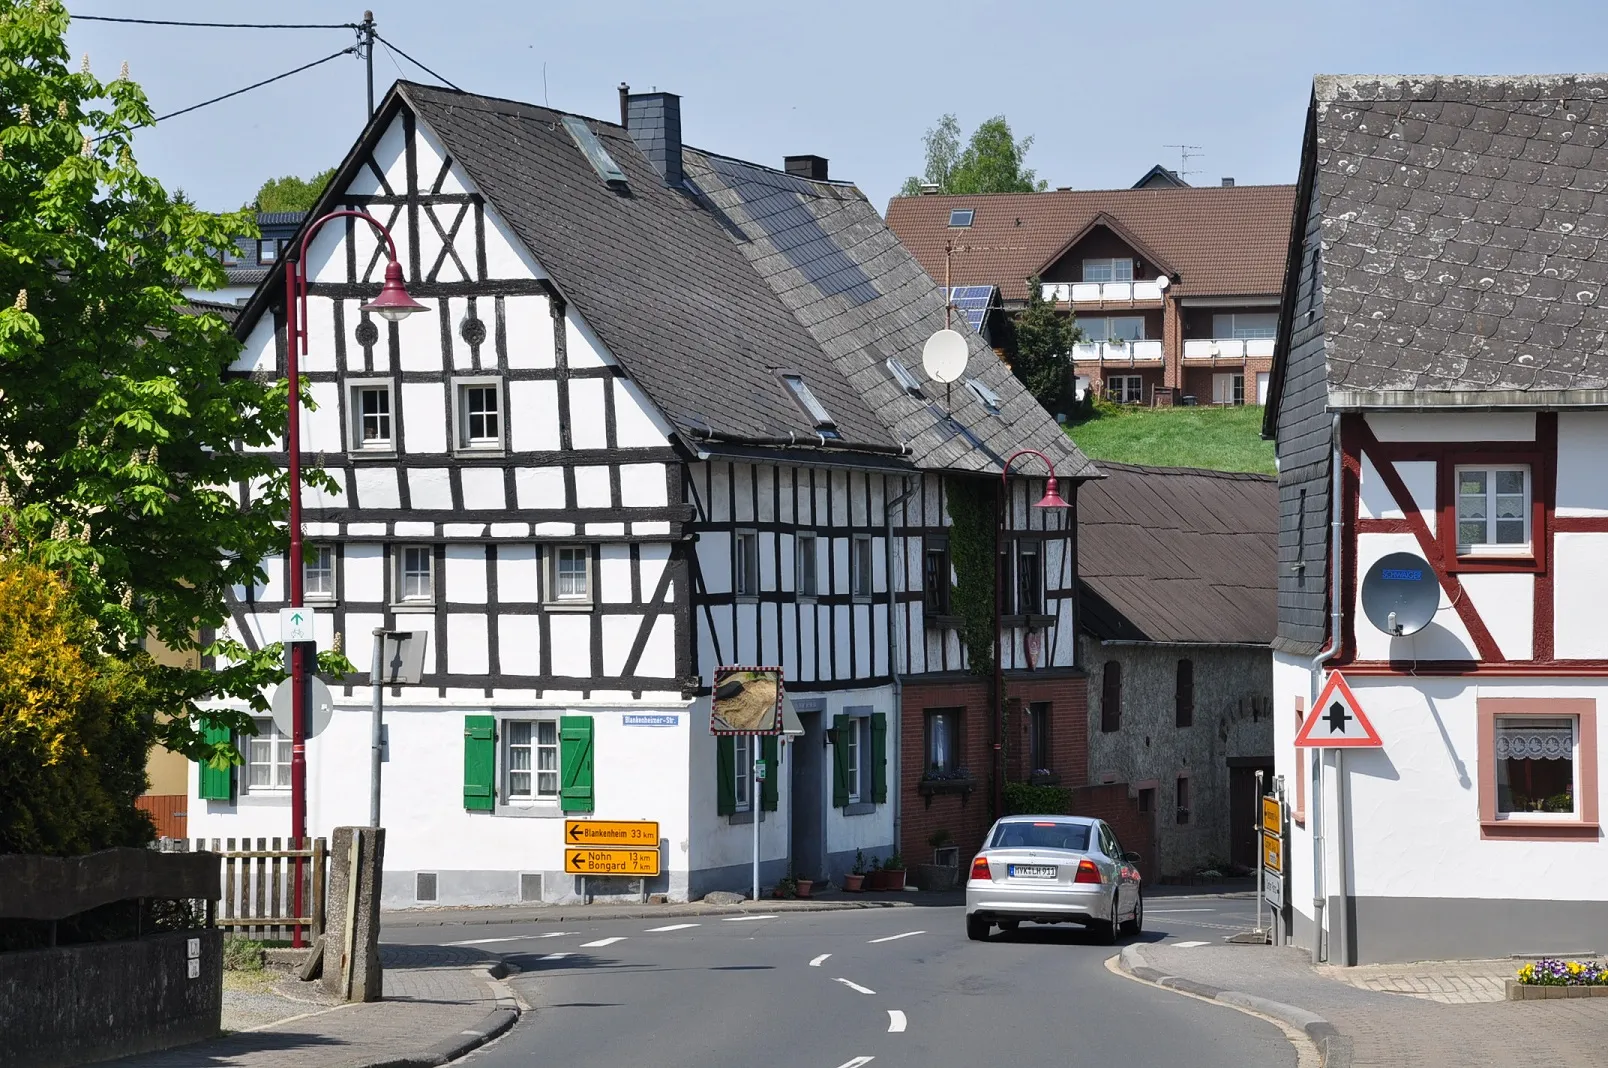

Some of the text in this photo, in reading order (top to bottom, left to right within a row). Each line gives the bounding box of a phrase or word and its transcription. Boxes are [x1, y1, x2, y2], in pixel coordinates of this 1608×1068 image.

[584, 828, 627, 838] Blankenheim
[631, 829, 642, 838] 33
[588, 852, 612, 861] Nohn
[629, 852, 638, 861] 13
[588, 861, 626, 872] Bongard
[632, 862, 638, 870] 7
